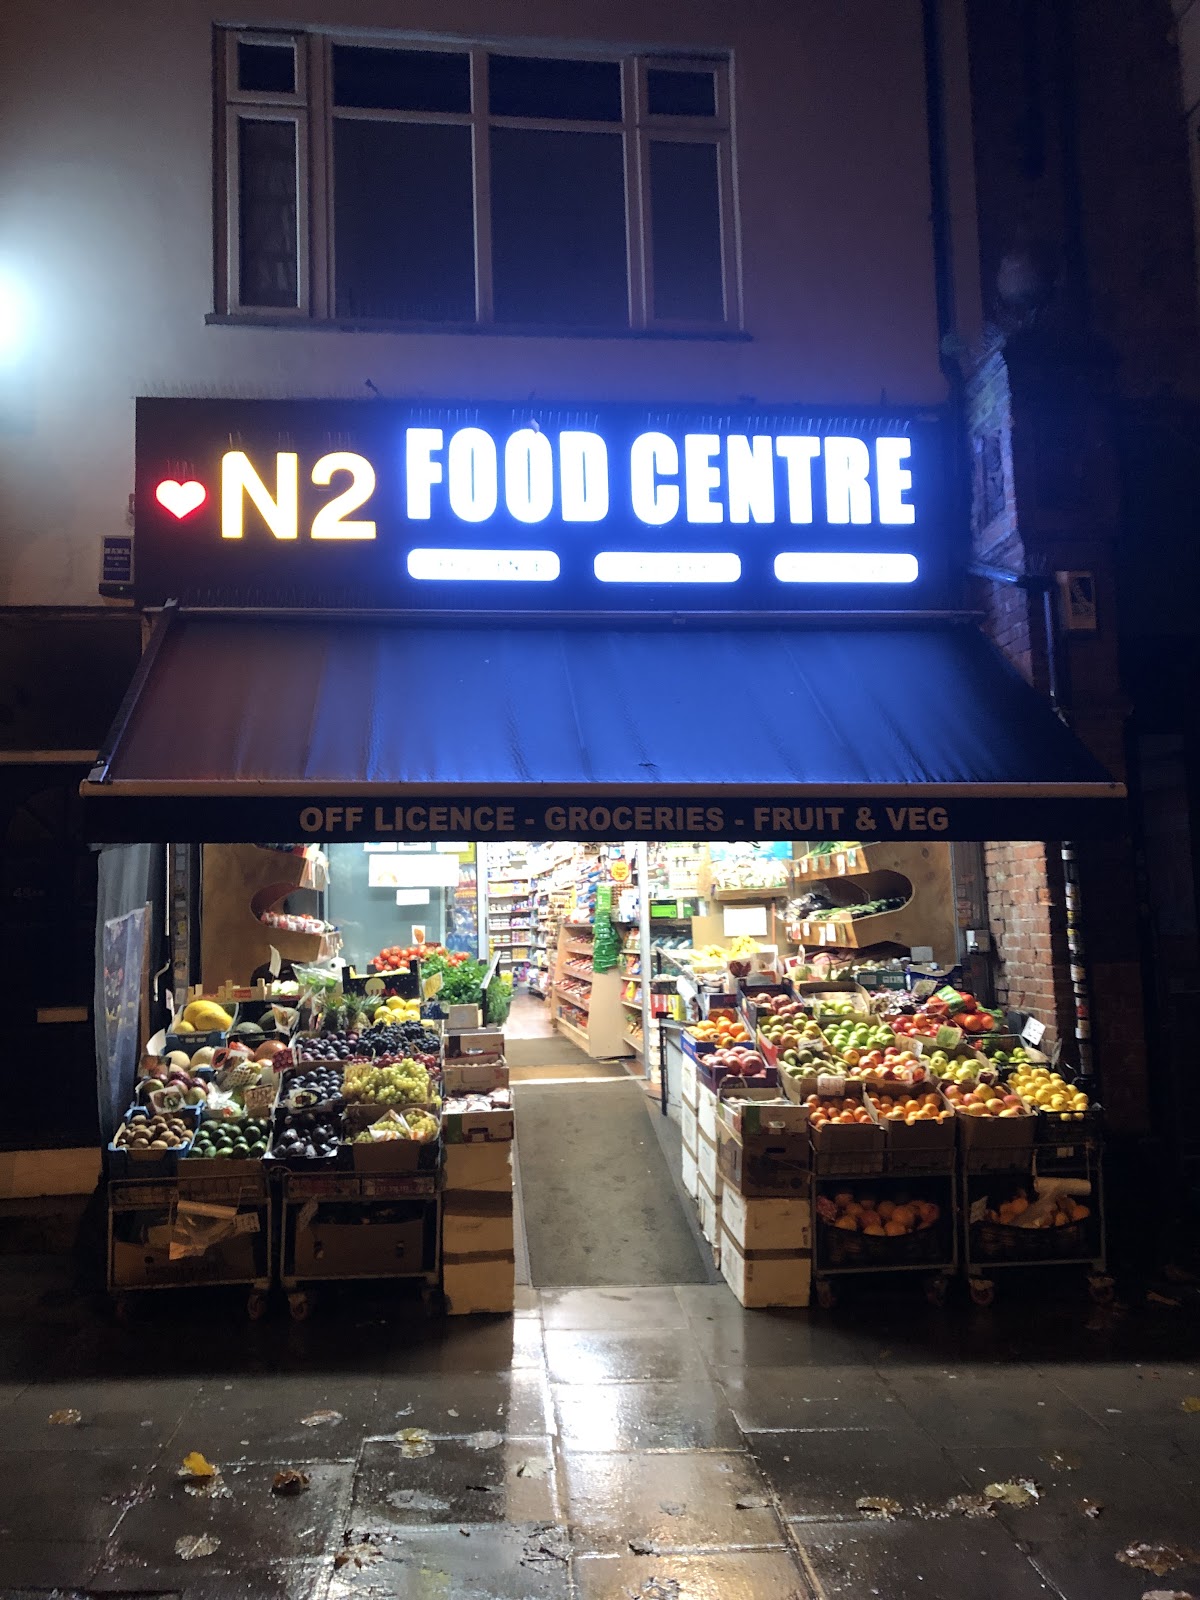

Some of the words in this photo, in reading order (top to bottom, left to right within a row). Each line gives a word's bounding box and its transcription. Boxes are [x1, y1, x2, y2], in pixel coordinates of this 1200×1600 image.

[220, 450, 377, 540] N2
[405, 425, 609, 523] FOOD
[630, 431, 916, 526] CENTRE
[299, 807, 362, 832] OFF
[374, 807, 514, 831] LICENCE
[544, 806, 723, 832] GROCERIES
[754, 806, 843, 831] FRUIT
[855, 806, 876, 831] &
[887, 806, 949, 831] VEG
